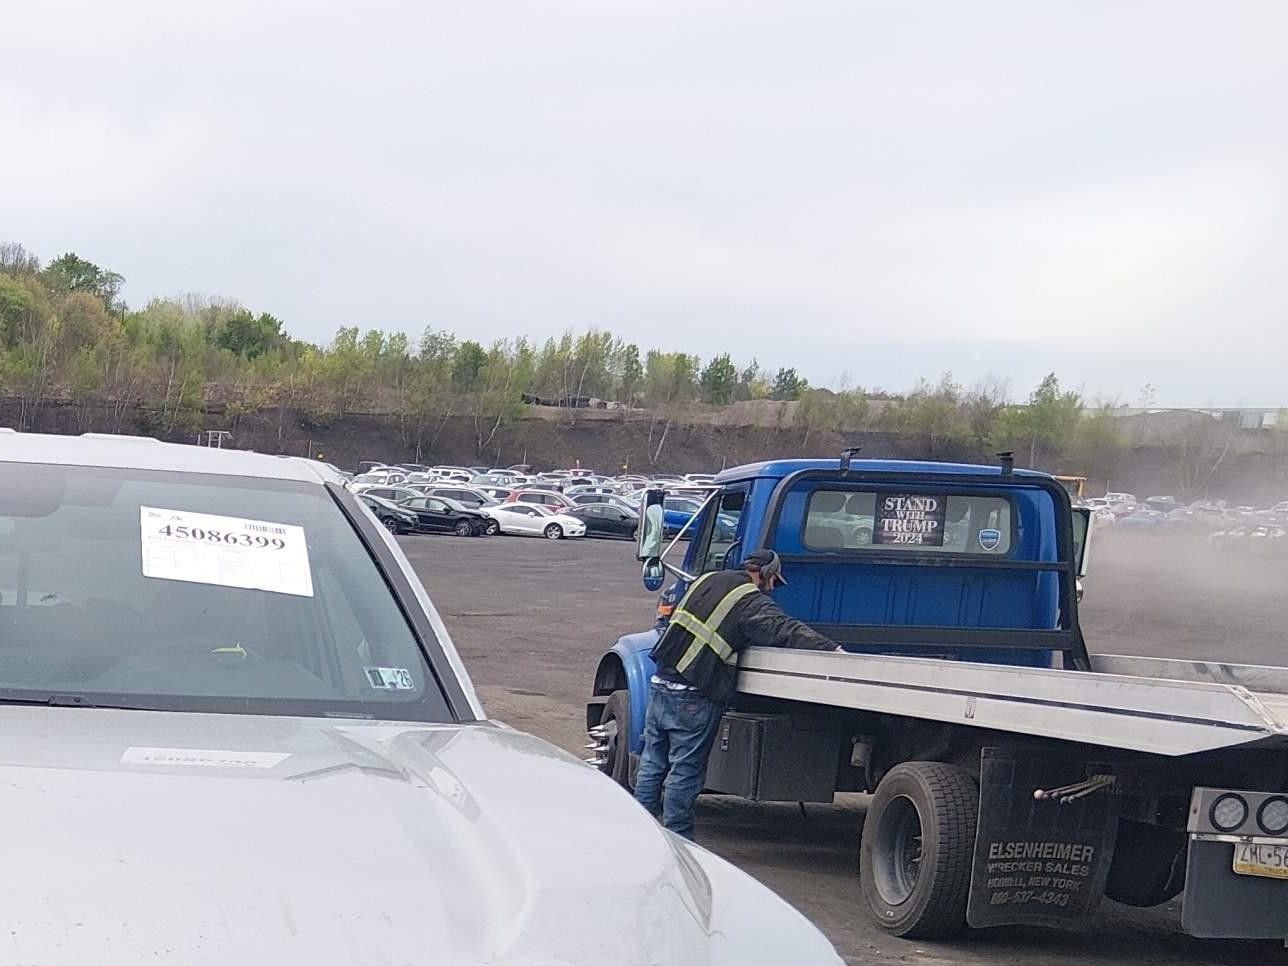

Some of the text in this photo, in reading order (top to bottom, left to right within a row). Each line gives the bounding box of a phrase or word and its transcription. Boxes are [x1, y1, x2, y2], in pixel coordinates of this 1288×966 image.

[884, 497, 937, 512] STAND
[896, 511, 925, 520] WITH
[881, 519, 938, 533] TRUMP
[158, 524, 286, 550] 45086399
[893, 533, 923, 544] 2024
[989, 842, 1094, 862] ELSENHEIMER
[987, 862, 1089, 876] WRECKER SALES
[1028, 877, 1051, 886] NEW
